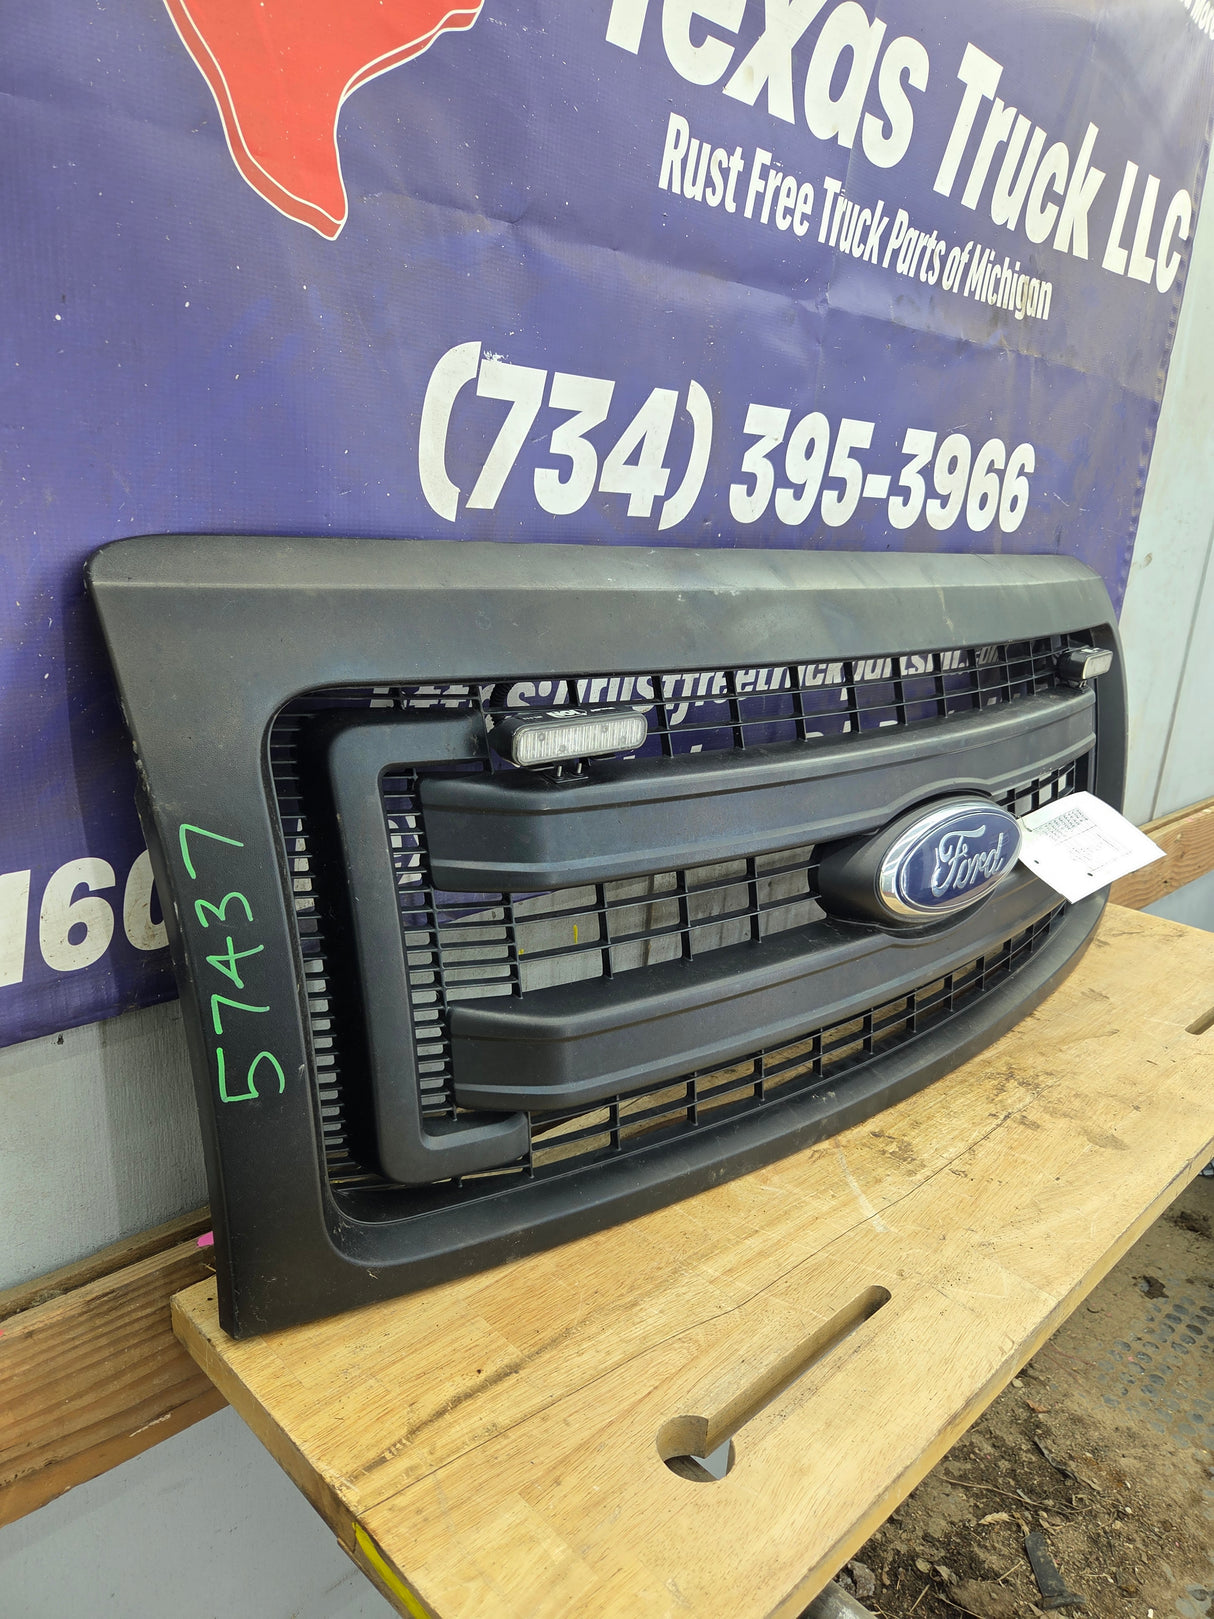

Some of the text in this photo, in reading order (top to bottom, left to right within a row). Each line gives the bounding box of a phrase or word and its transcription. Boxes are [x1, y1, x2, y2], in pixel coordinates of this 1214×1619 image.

[605, 0, 1192, 293] exas Truck LLC
[658, 112, 1053, 320] Rust Free Truck Parts of Michigan
[418, 341, 1035, 533] (734) 395-3966
[178, 823, 286, 1103] 57437
[931, 824, 1003, 897] Ford
